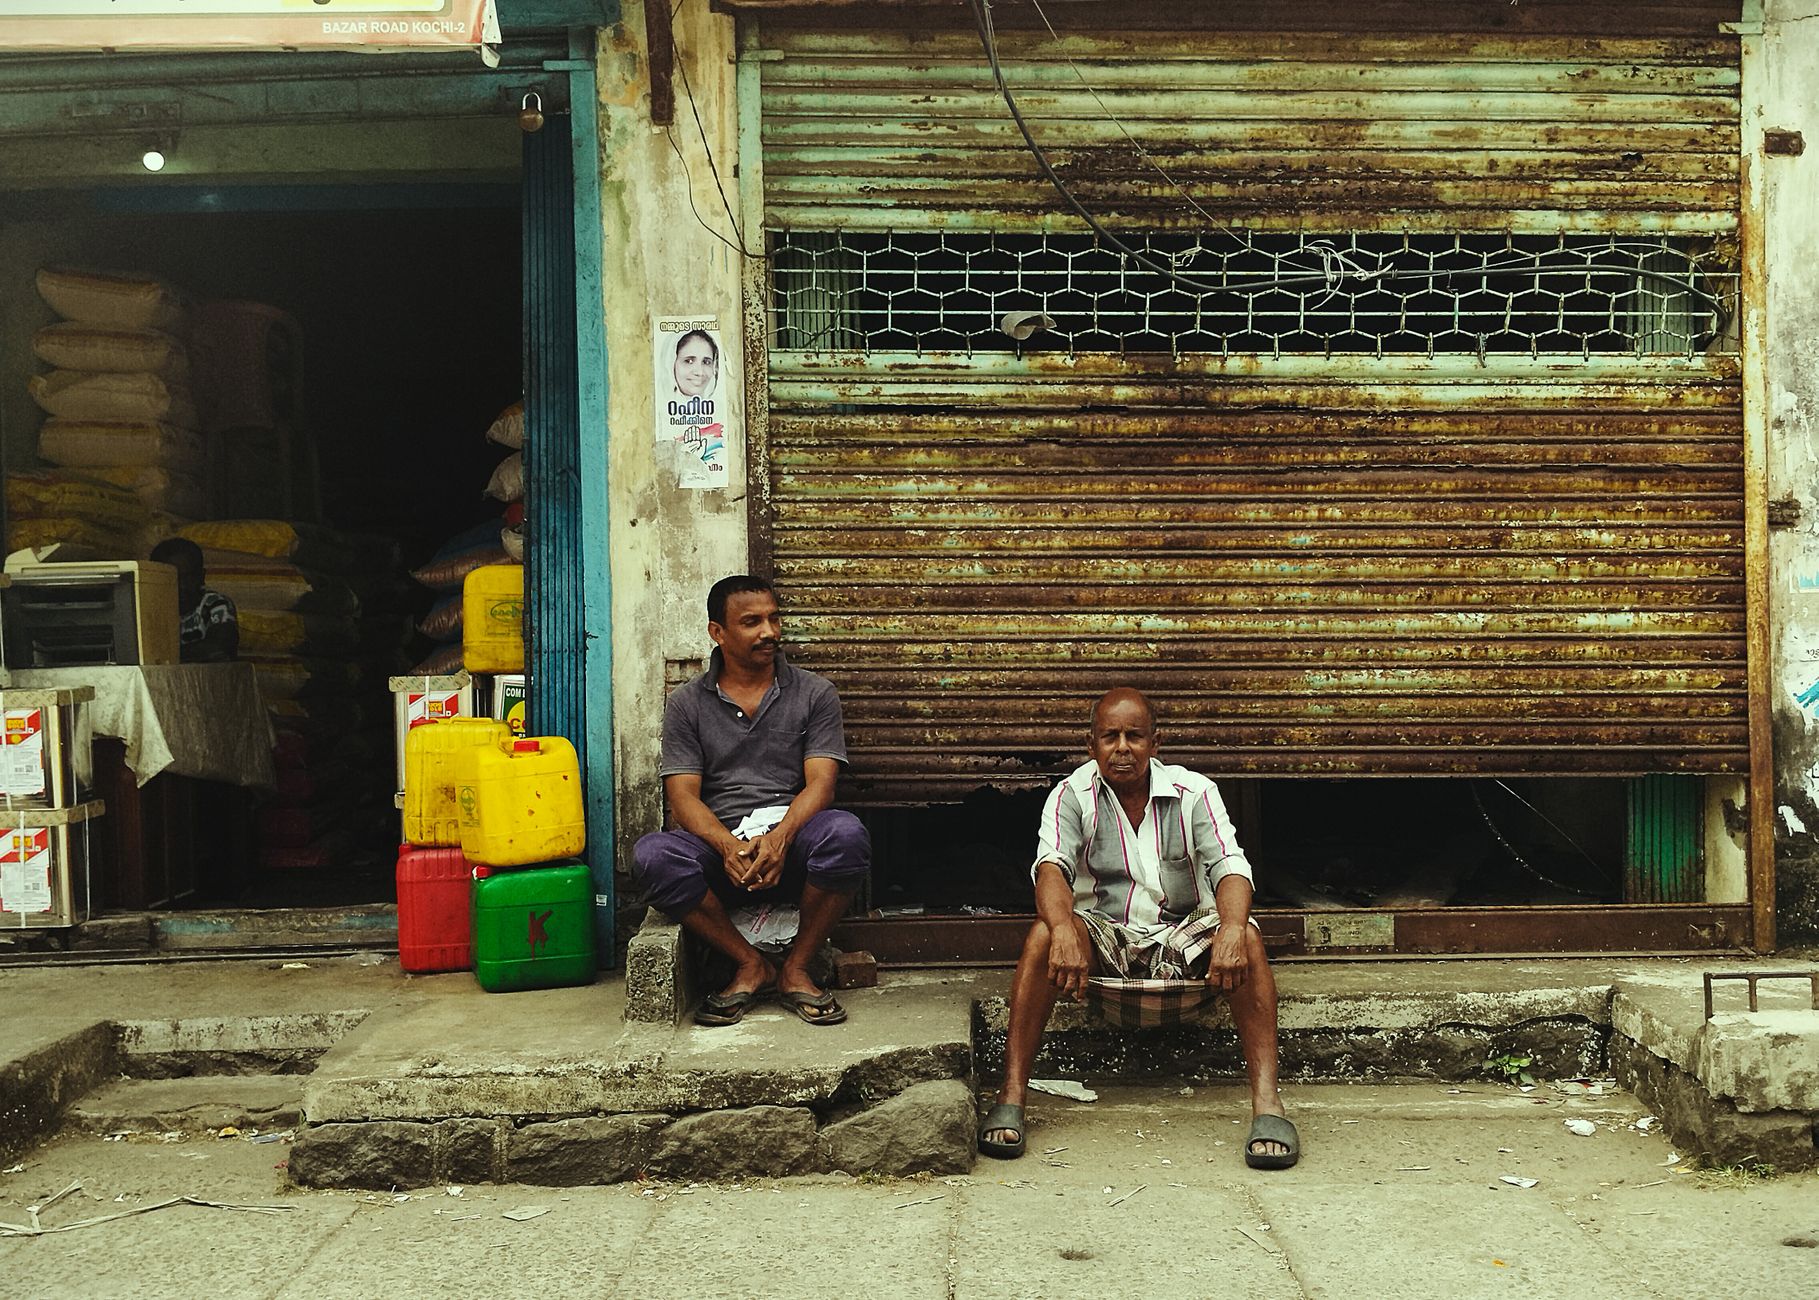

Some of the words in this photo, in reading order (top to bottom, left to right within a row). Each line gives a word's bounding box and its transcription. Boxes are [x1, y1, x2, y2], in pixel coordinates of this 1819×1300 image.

[322, 21, 366, 34] BAZAR
[370, 21, 409, 34] ROAD
[412, 21, 465, 33] KOCHI-2
[668, 396, 714, 416] റഹീന
[528, 910, 553, 951] K
